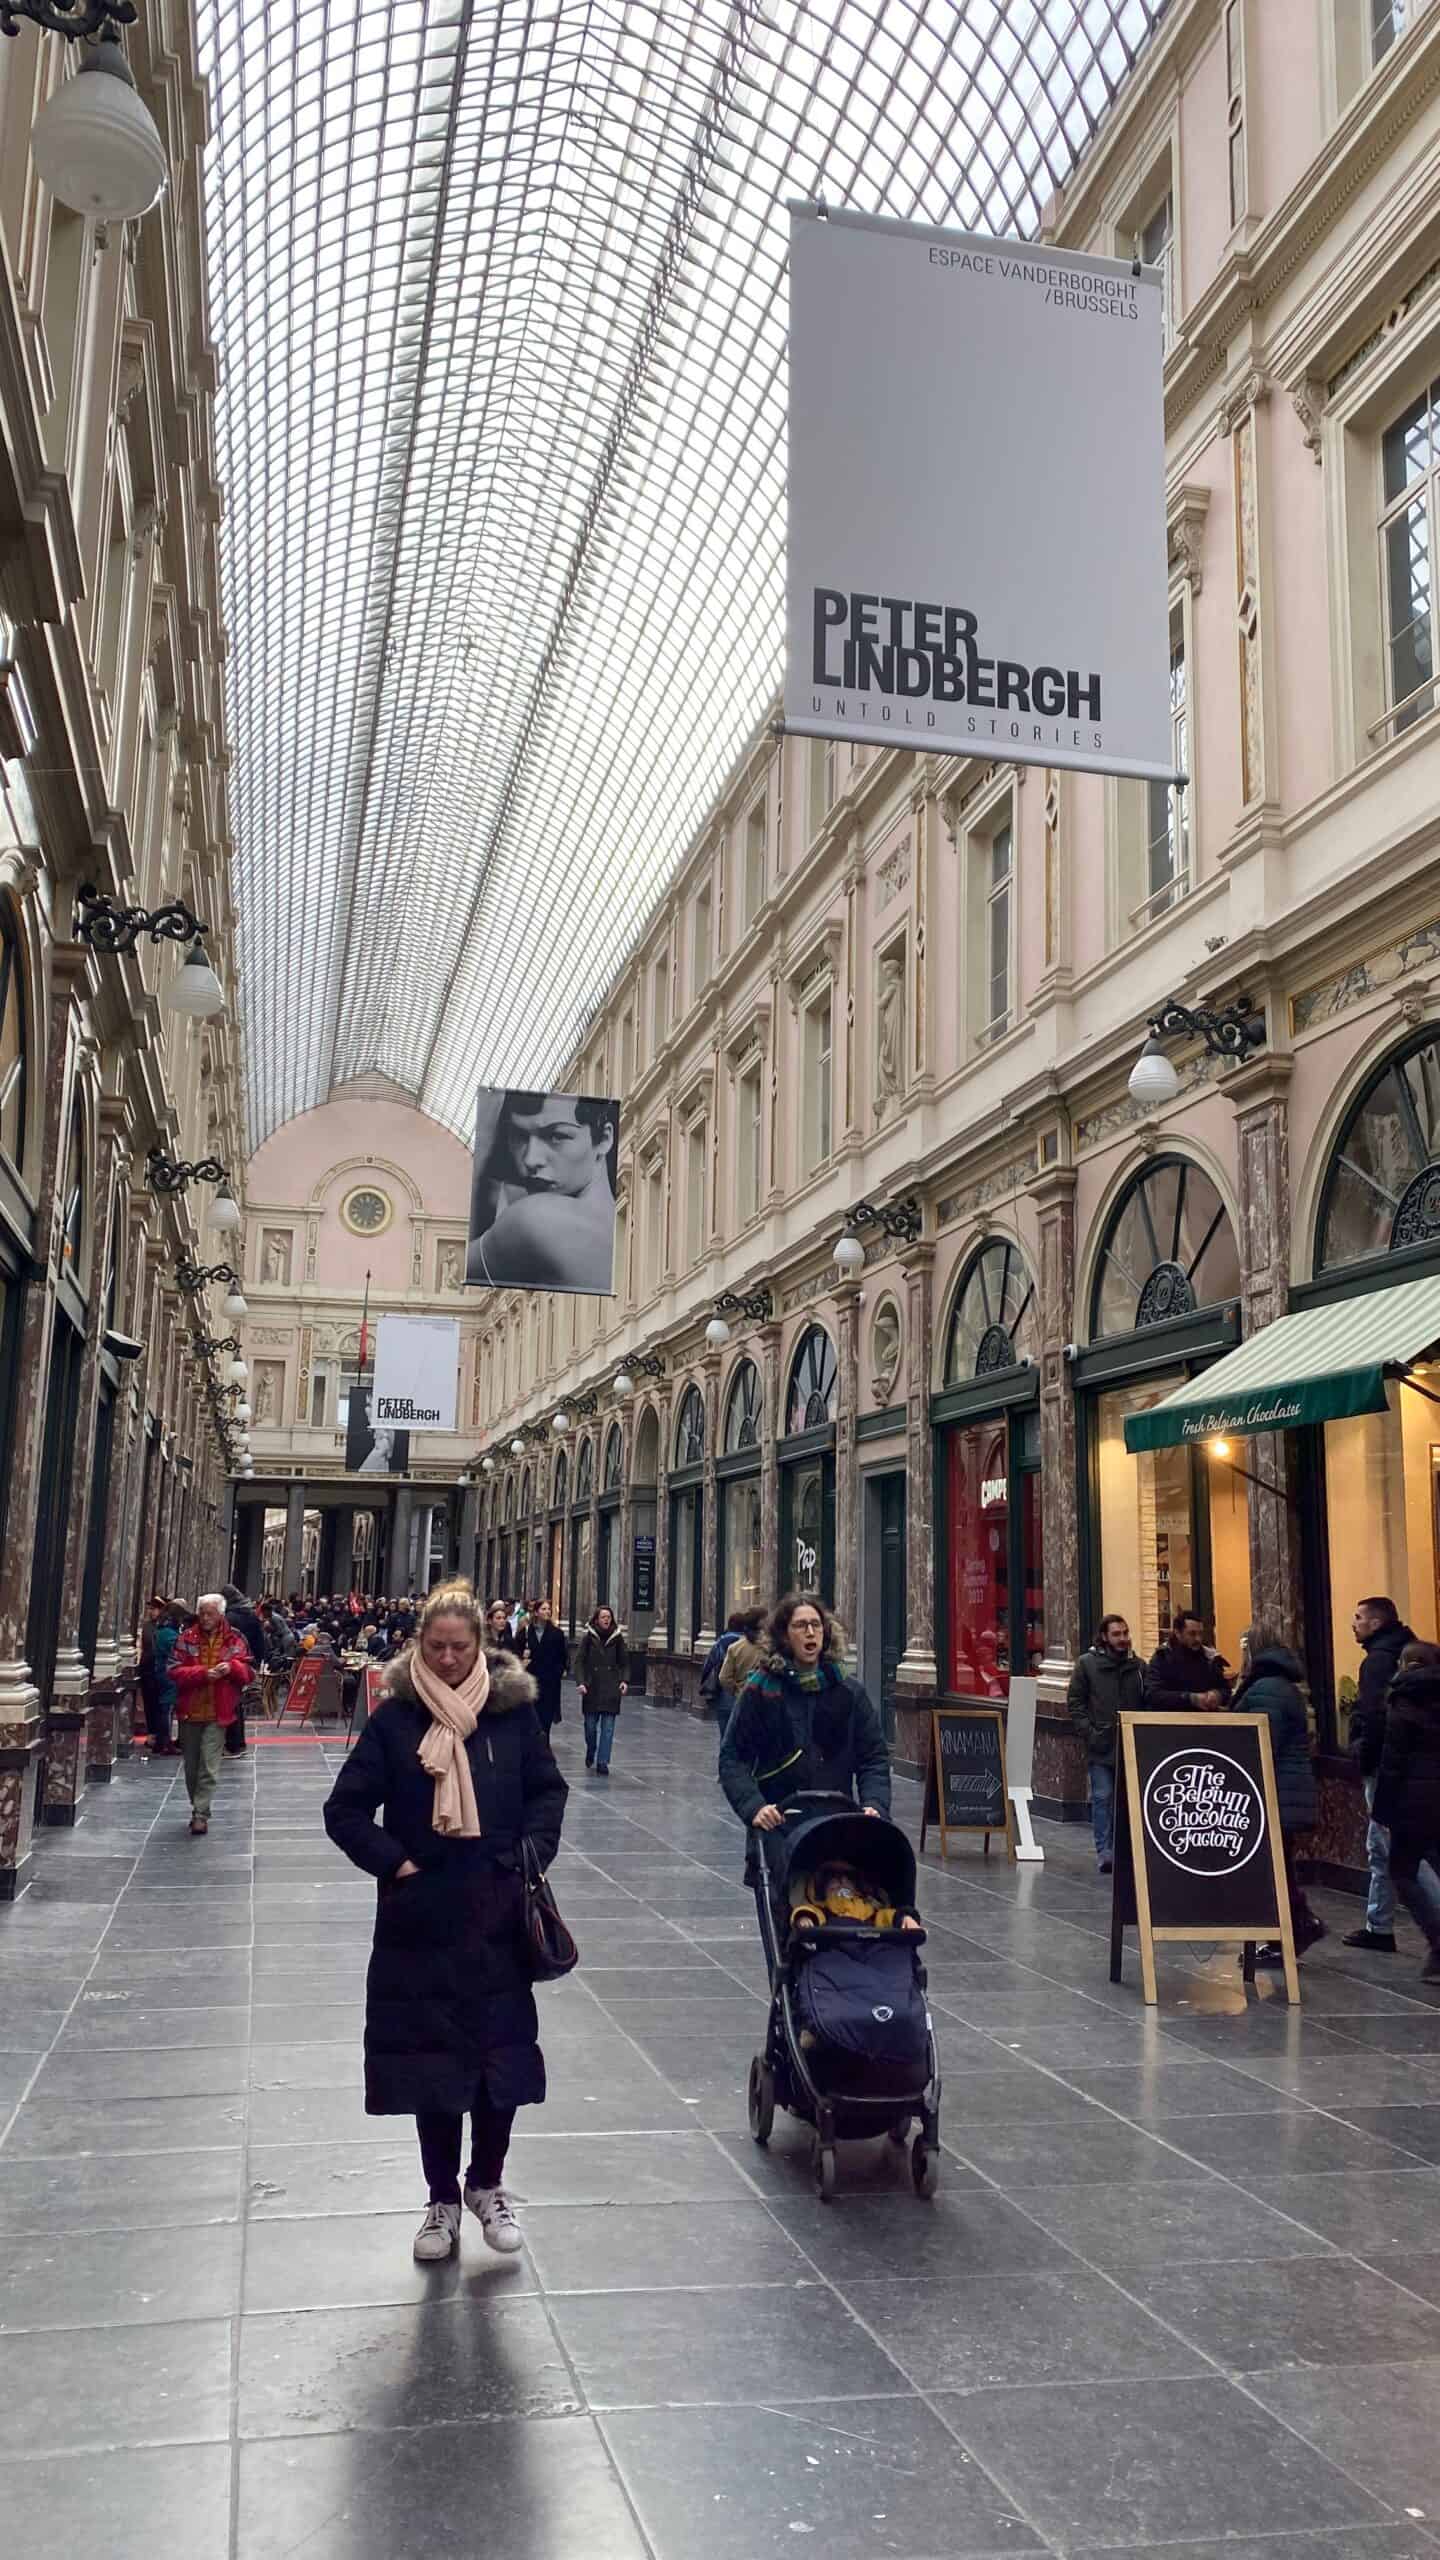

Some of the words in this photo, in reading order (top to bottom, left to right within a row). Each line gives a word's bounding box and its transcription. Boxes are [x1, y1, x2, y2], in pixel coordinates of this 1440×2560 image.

[929, 247, 994, 274] ESPACE
[1000, 260, 1137, 301] VANDERBORGHT
[1045, 287, 1139, 321] /BRUSSELS
[813, 587, 978, 656] PETER
[813, 640, 1102, 722] LINDBERGH
[812, 695, 936, 728] UNTOLD
[967, 716, 1103, 749] STORIES
[377, 1407, 440, 1421] LINDBERGH
[378, 1398, 414, 1410] PETER
[1182, 1413, 1206, 1436] Fresh
[1206, 1410, 1246, 1434] Belgian
[1247, 1398, 1301, 1424] Chocolates
[1173, 1764, 1225, 1789] The
[1153, 1782, 1251, 1815] Belgium
[1159, 1802, 1250, 1831] Chocolate
[1169, 1826, 1244, 1857] Factory
